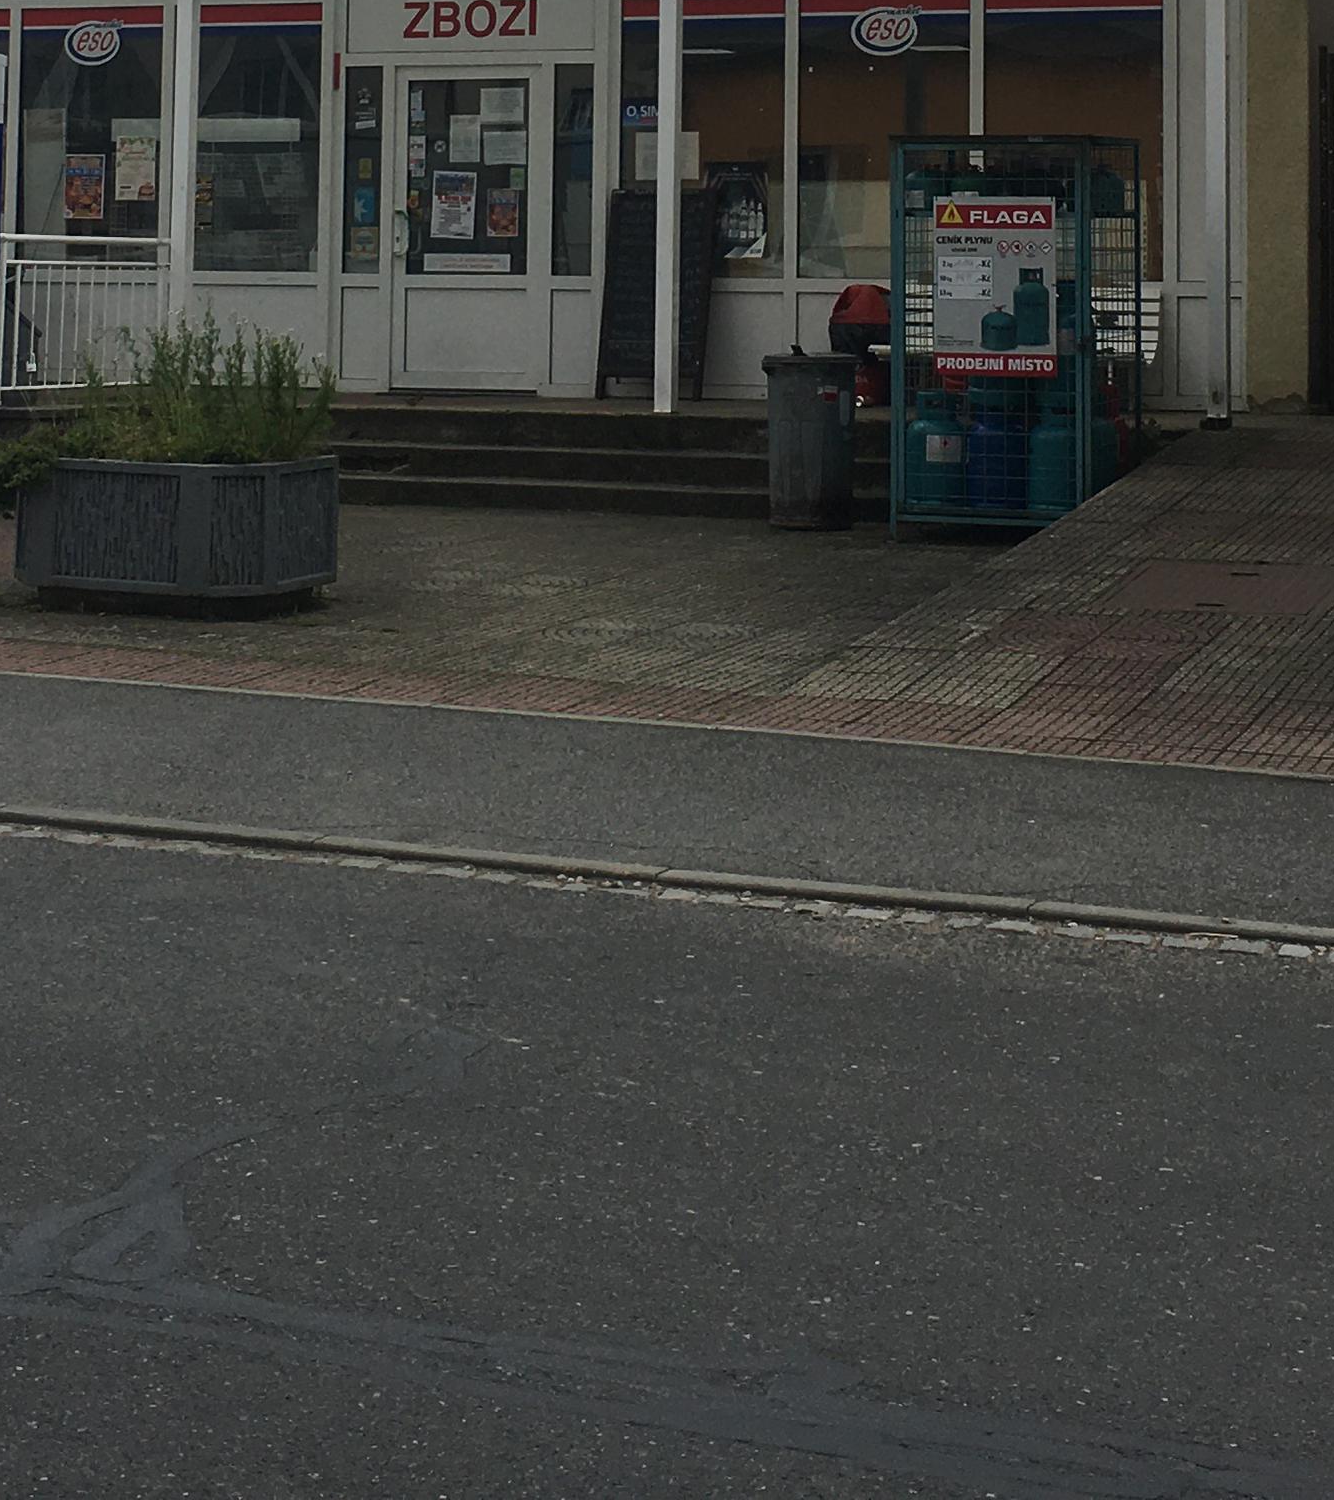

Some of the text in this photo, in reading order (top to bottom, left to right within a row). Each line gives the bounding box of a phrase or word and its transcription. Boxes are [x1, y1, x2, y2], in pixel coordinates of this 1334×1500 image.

[866, 17, 911, 41] eso
[76, 29, 115, 52] eso
[969, 210, 1047, 224] FLAGA
[965, 236, 993, 245] PLYNU
[937, 356, 1054, 371] PRODEJNÍ MÍSTO
